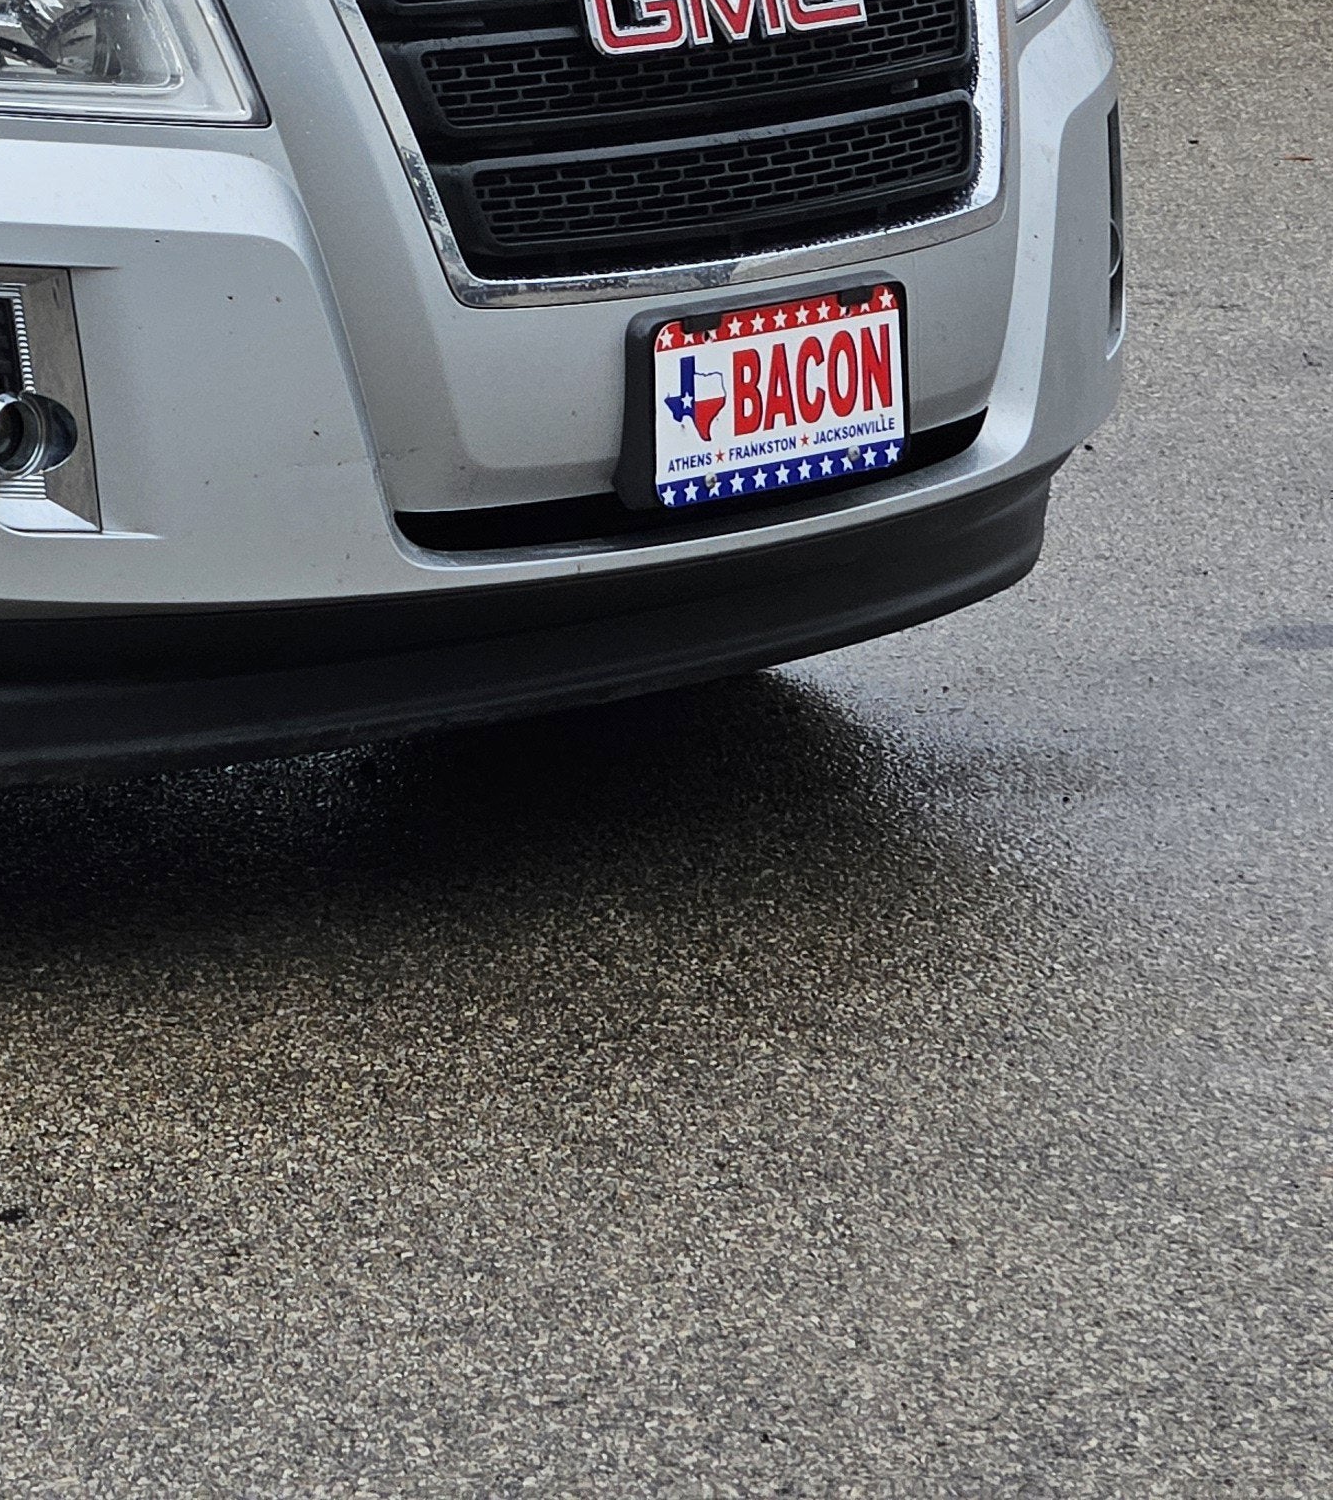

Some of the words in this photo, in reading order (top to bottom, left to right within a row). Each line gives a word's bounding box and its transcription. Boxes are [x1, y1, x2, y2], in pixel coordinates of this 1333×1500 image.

[732, 323, 894, 437] BACON
[668, 451, 713, 474] ATHENS
[728, 435, 797, 462] FRANKSTON
[812, 417, 896, 446] JACKSONVILLE
